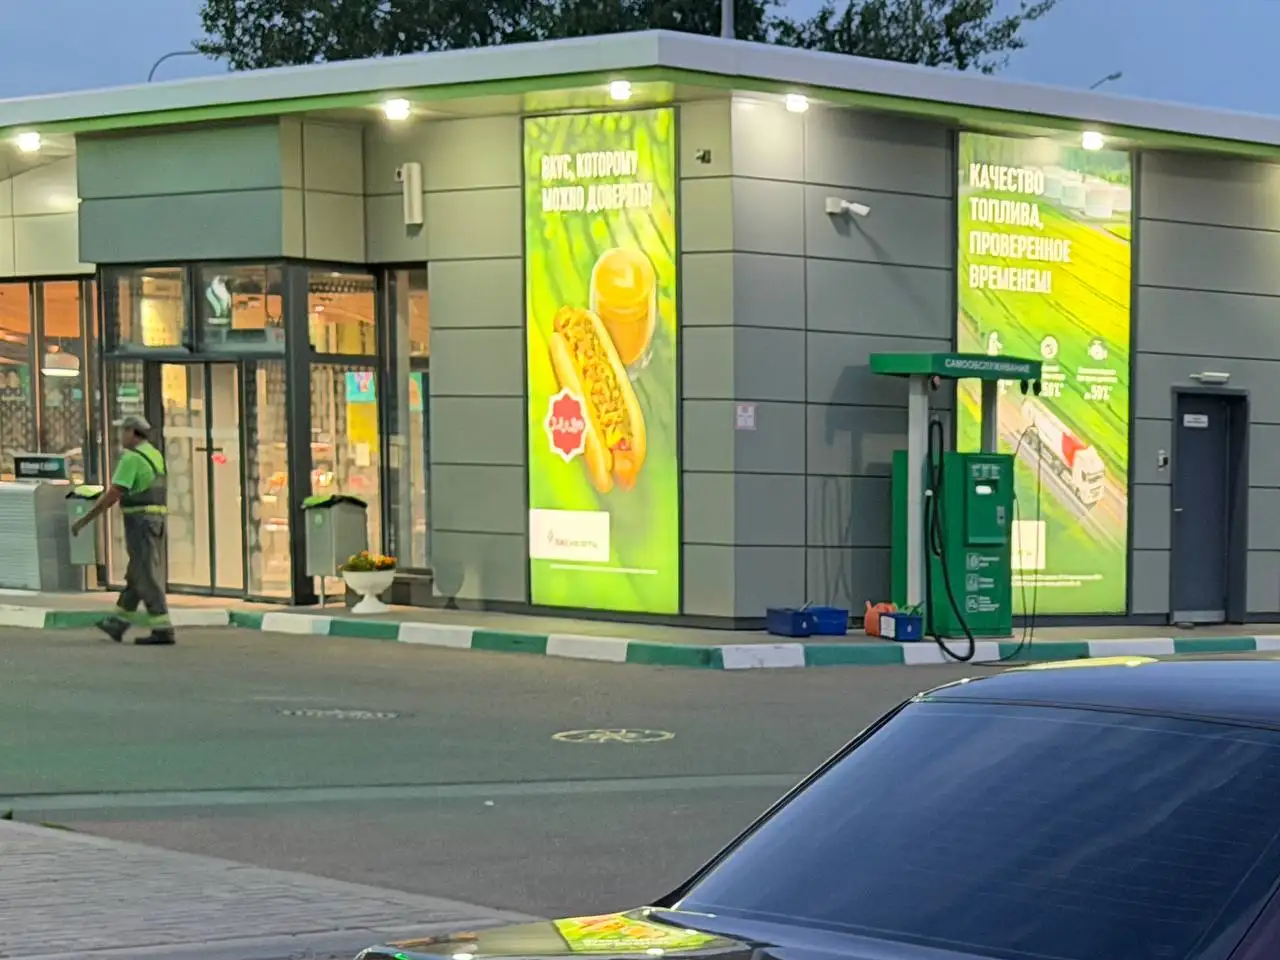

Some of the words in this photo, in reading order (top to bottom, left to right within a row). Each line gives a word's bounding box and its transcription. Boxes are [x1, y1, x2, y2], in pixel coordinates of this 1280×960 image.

[576, 150, 638, 178] КОТОРОМУ
[969, 163, 1044, 195] КАЧЕСТВО
[541, 186, 585, 212] МОЖНО
[969, 197, 1044, 230] ТОПЛИВА,
[969, 231, 1072, 263] ПРОВЕРЕННОЕ
[969, 264, 1052, 294] ВРЕМЕНЕМ!
